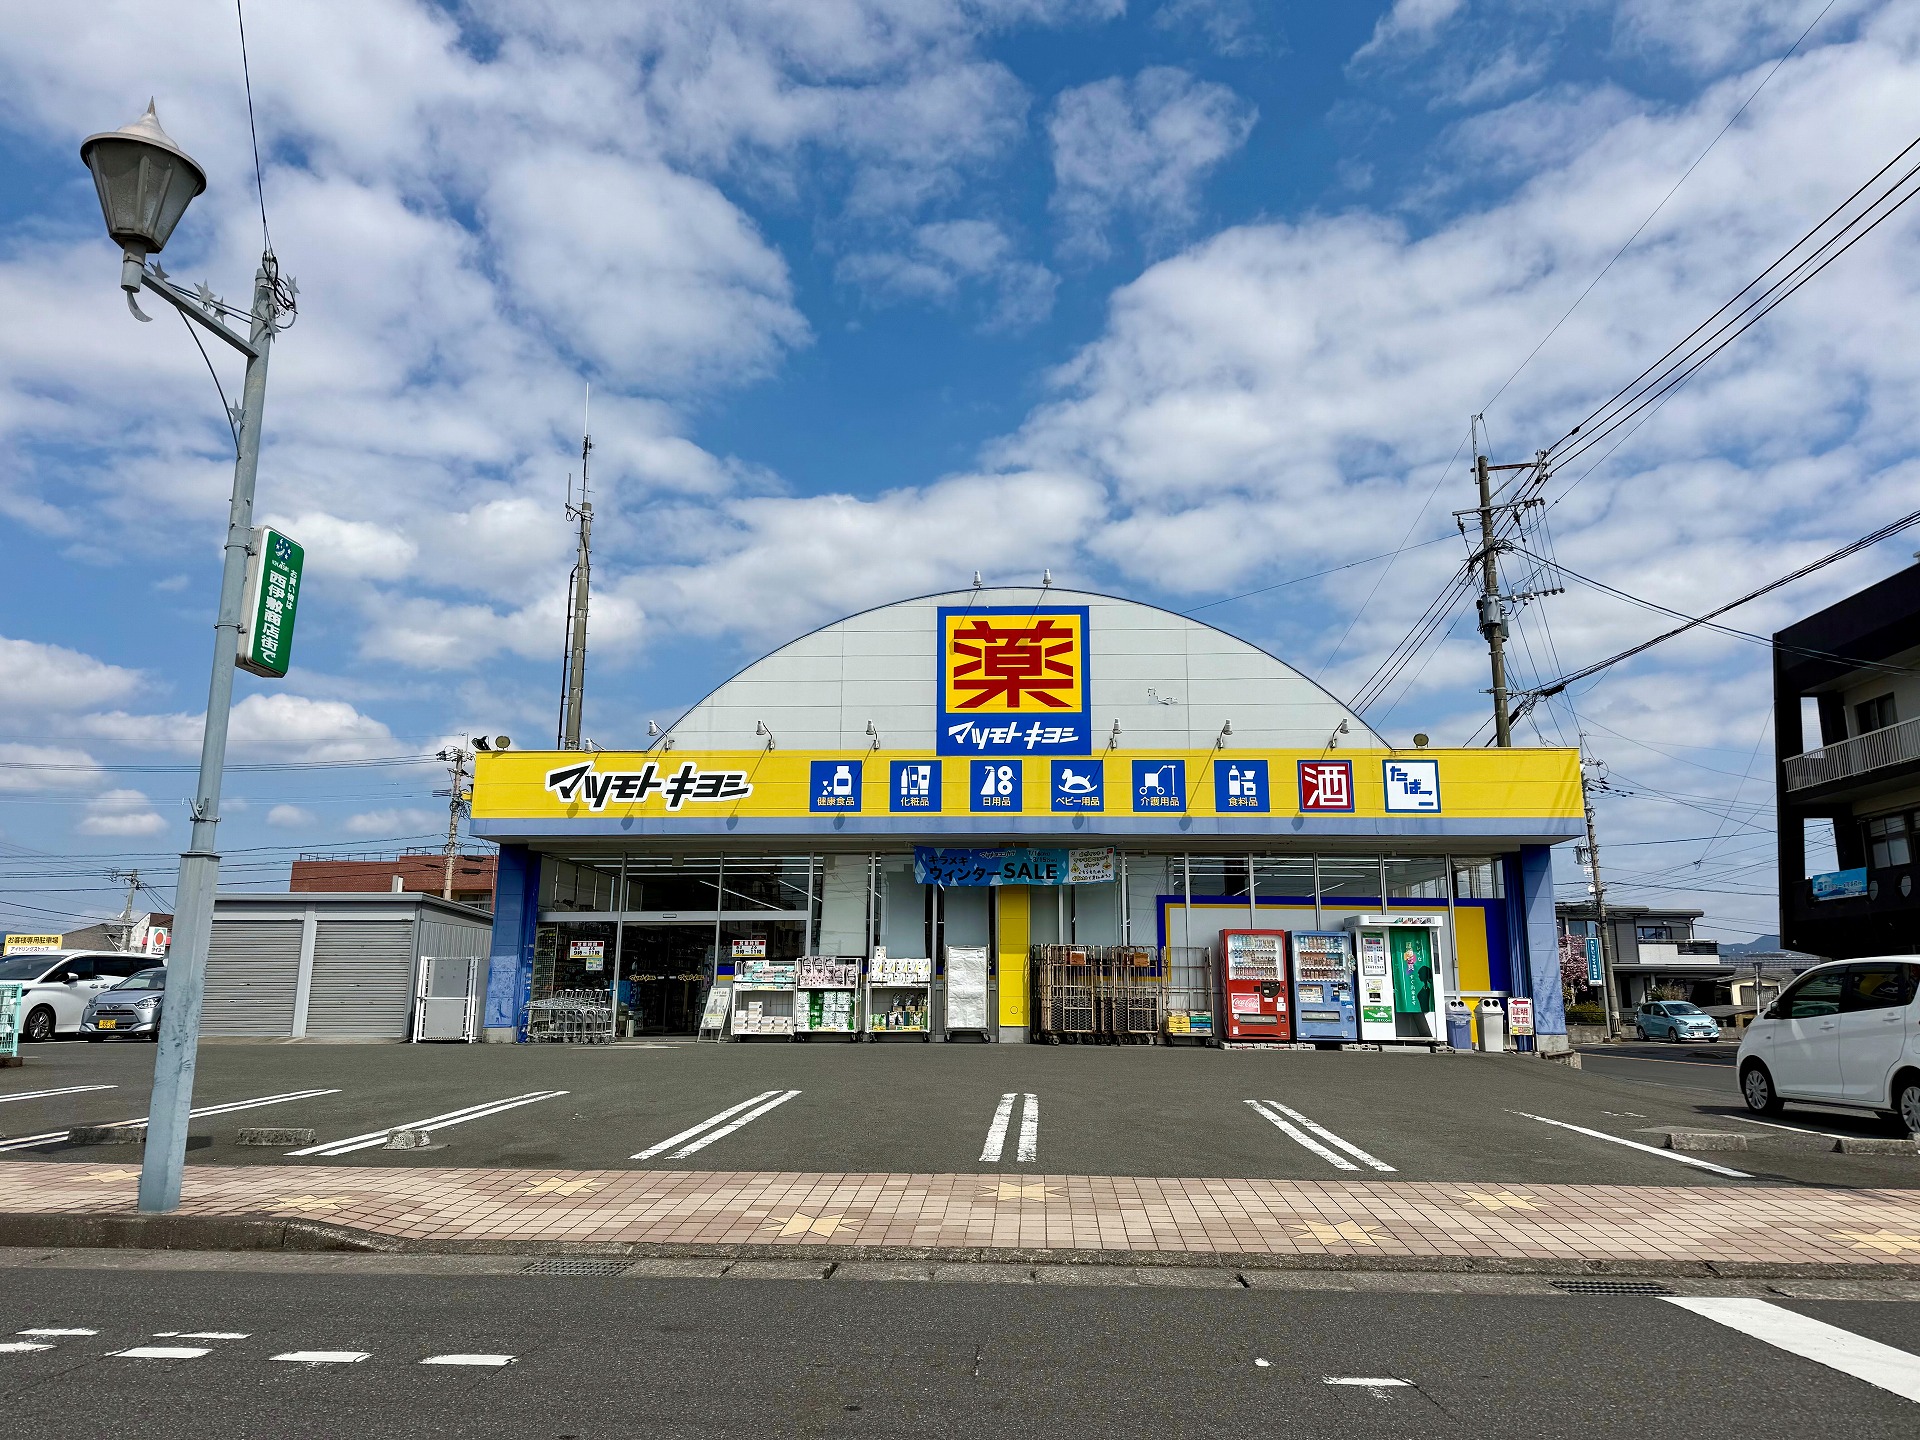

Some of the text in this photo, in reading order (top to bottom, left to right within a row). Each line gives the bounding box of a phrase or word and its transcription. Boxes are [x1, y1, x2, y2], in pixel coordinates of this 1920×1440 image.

[260, 569, 288, 664] 西伊敷商店街で
[953, 619, 1074, 709] 薬
[948, 720, 1079, 750] マツモトキヨシ
[547, 763, 751, 809] マツモトキヨシ
[1303, 765, 1348, 806] 酒
[1389, 765, 1434, 807] たばこ
[816, 796, 855, 807] 健康食品
[900, 796, 930, 807] 化粧品
[982, 796, 1011, 807] 日用品
[1055, 796, 1100, 806] ベビー用品
[1140, 796, 1180, 807] 介護用品
[1228, 796, 1259, 807] 食料品
[928, 855, 969, 865] キラメキ
[8, 936, 59, 944] お客様専用駐車場
